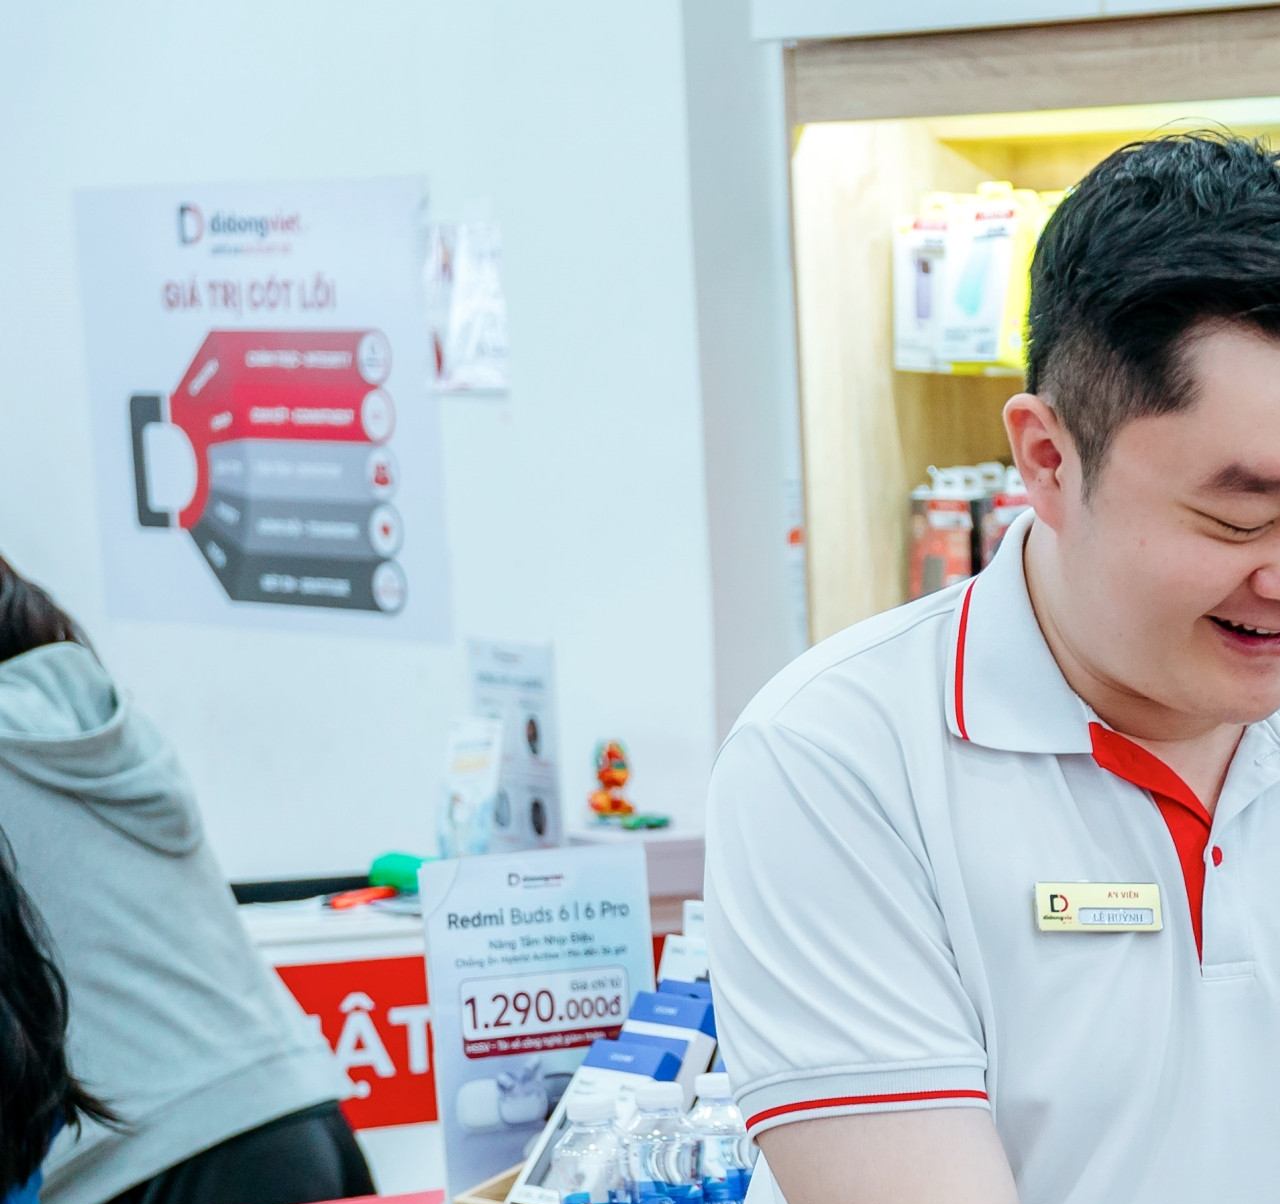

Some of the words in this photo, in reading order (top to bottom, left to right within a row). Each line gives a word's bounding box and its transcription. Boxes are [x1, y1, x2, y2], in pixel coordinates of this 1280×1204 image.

[448, 908, 505, 931] Redmi
[510, 905, 554, 926] Buds
[558, 905, 571, 922] 6
[584, 902, 596, 921] 6
[601, 901, 631, 919] Pro
[464, 989, 622, 1030] 1.290.000đ
[308, 991, 433, 1098] ẬT
